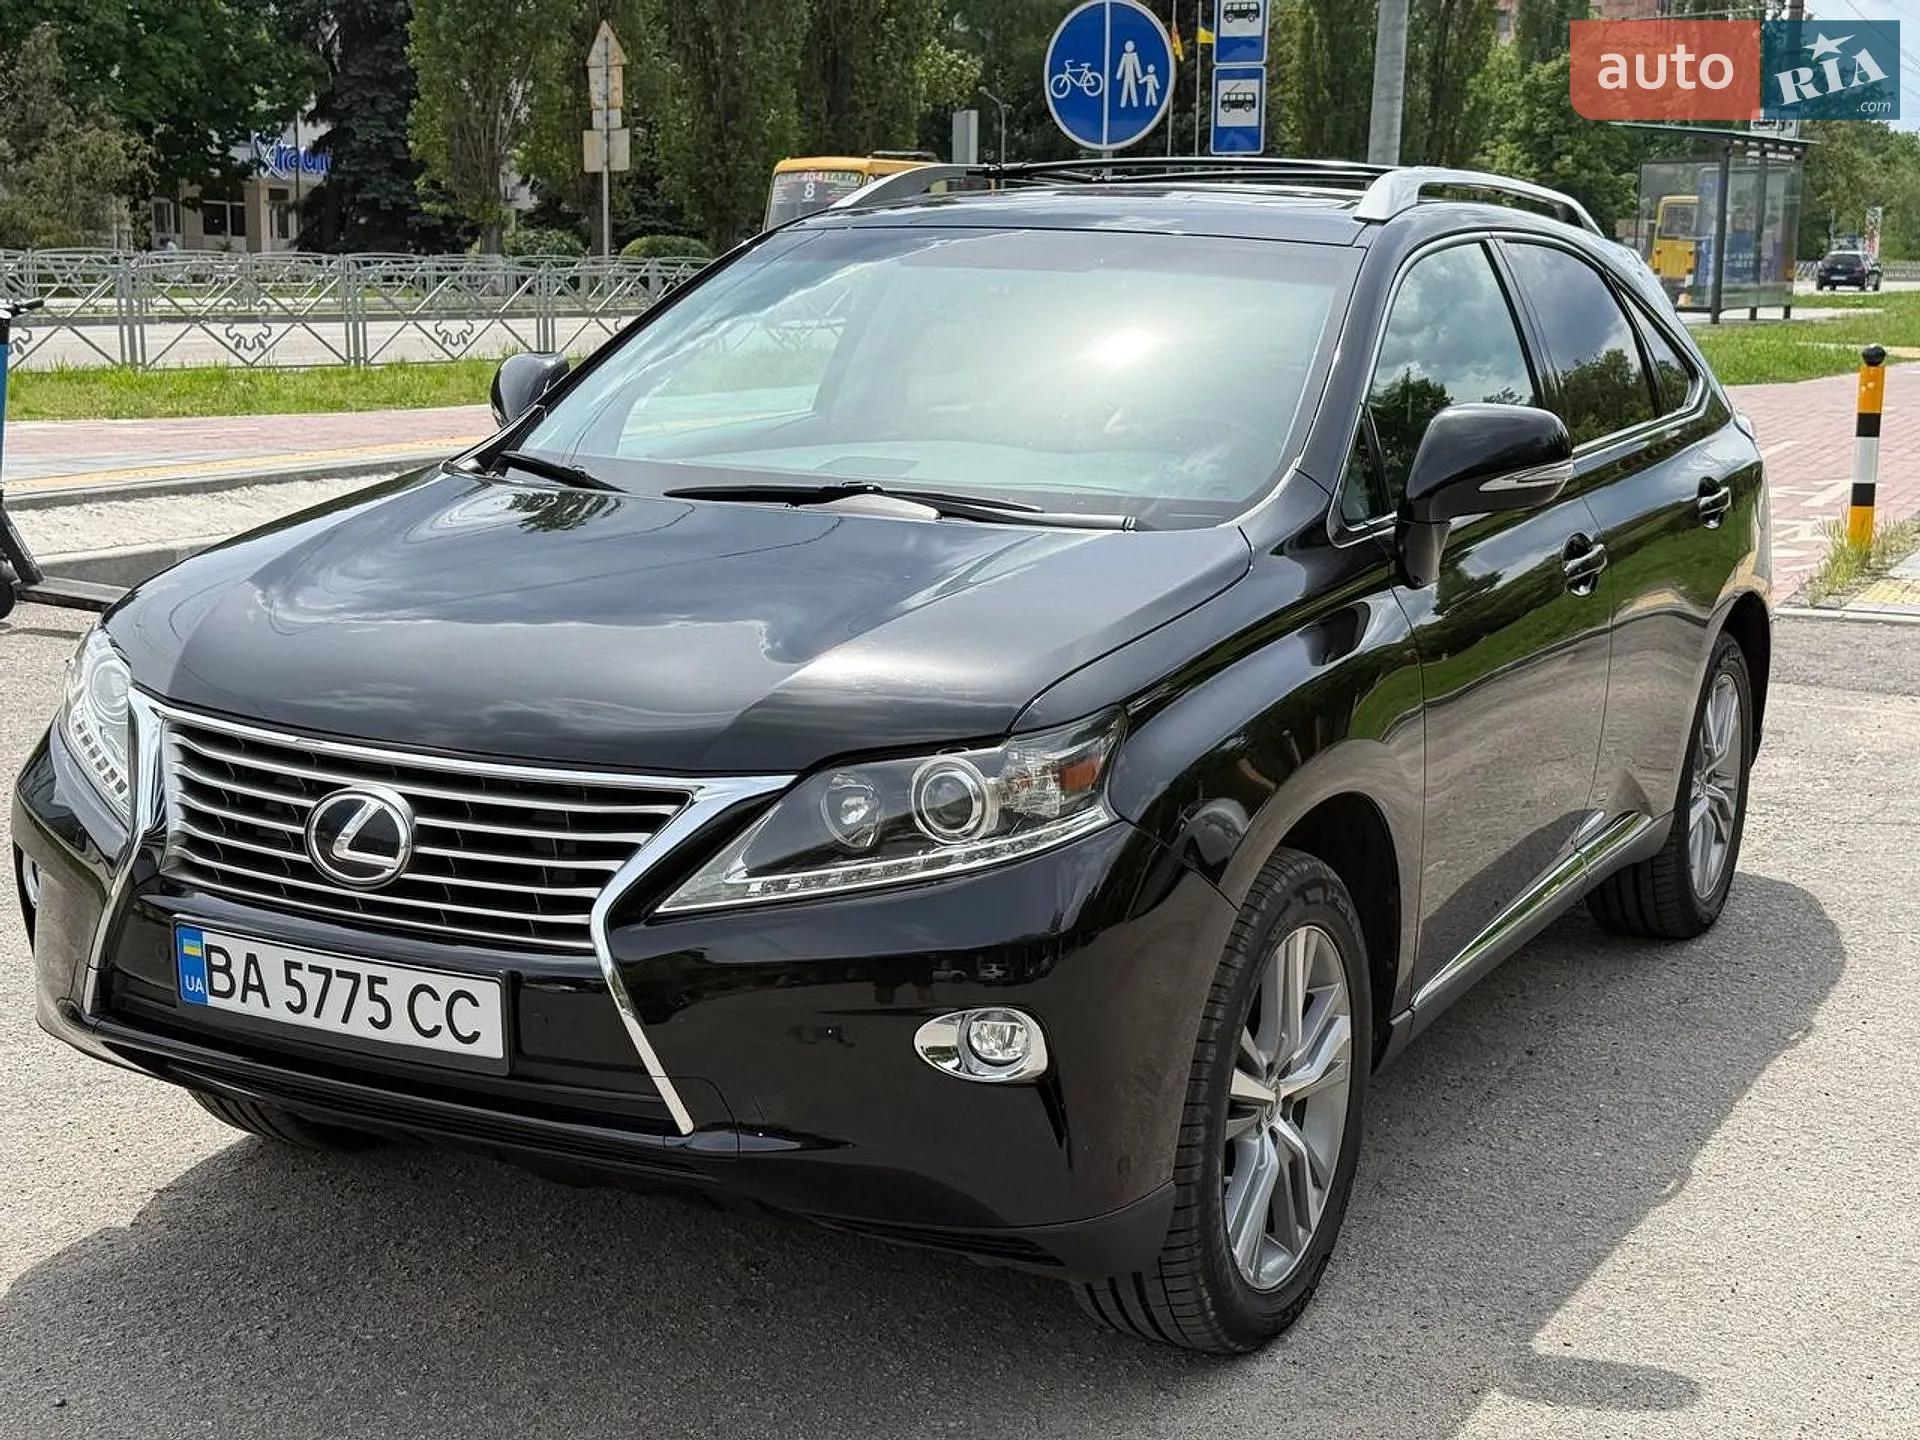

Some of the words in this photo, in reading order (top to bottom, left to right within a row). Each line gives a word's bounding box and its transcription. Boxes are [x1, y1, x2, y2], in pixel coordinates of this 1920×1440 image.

[804, 182, 816, 197] 8
[186, 974, 205, 993] UA
[204, 943, 270, 1008] BA
[283, 959, 392, 1031] 5775
[407, 983, 481, 1045] CC
